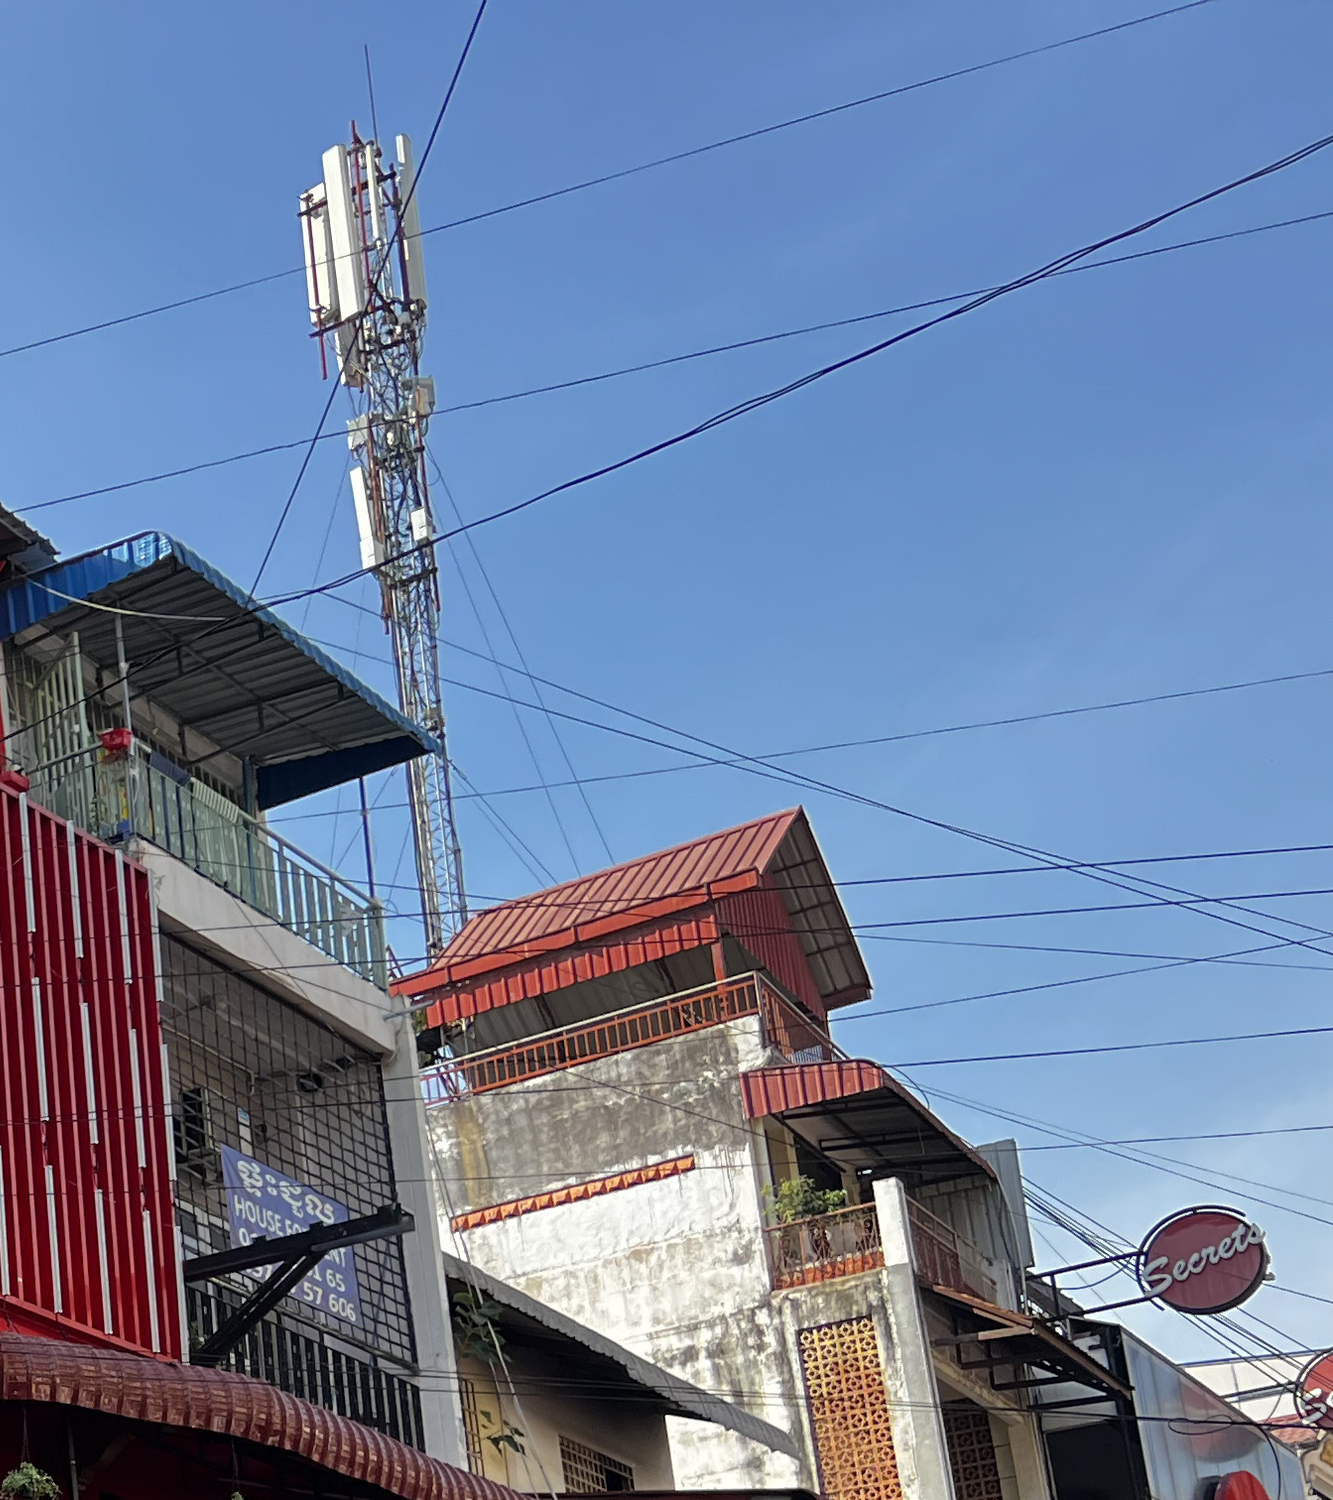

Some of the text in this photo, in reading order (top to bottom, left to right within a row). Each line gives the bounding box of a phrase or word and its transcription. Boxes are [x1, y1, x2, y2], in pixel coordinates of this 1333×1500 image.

[234, 1195, 283, 1237] HOUSE
[326, 1269, 346, 1292] 65
[1143, 1223, 1266, 1297] Secrets
[303, 1282, 357, 1322] 57 606
